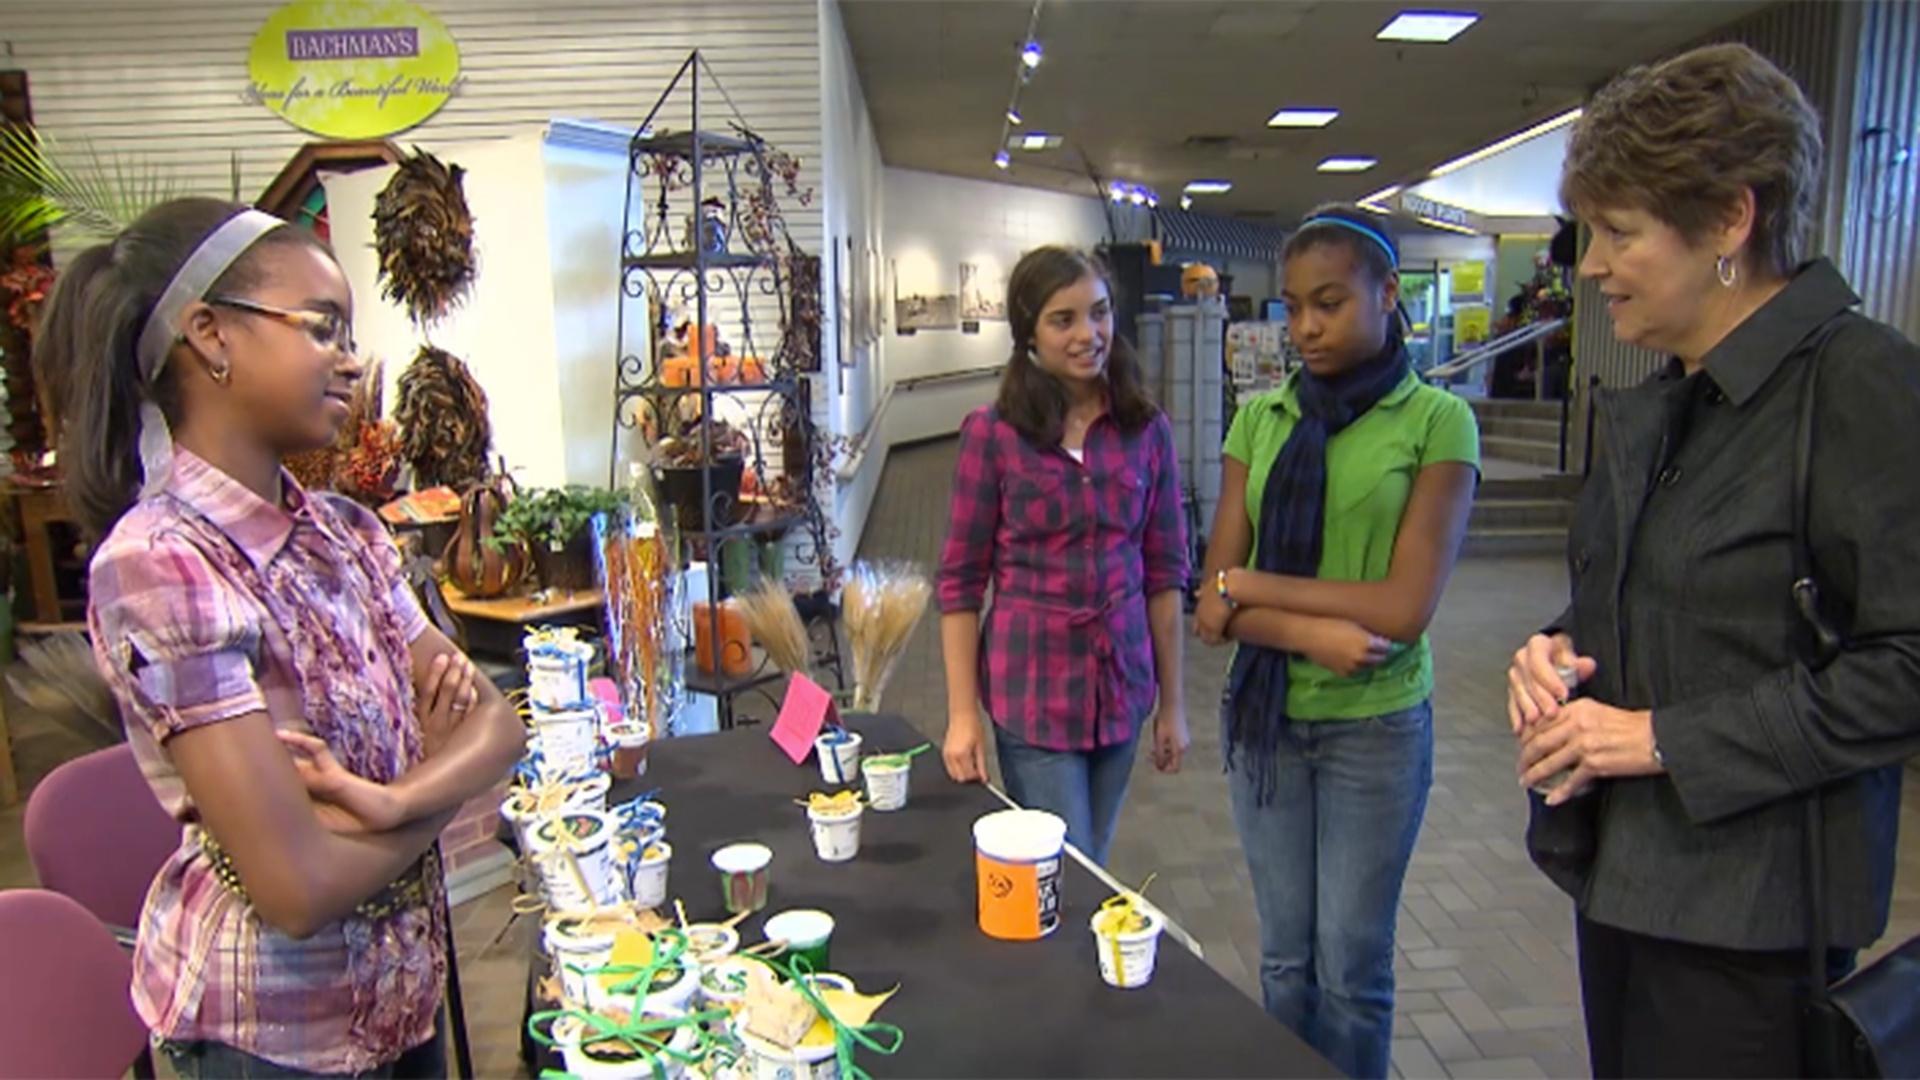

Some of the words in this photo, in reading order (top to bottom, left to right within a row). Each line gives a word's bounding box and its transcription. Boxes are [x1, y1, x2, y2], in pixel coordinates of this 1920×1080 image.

[292, 32, 414, 58] BACHMAN'S
[281, 76, 310, 112] for
[313, 88, 325, 98] a
[328, 74, 413, 110] Beautiful
